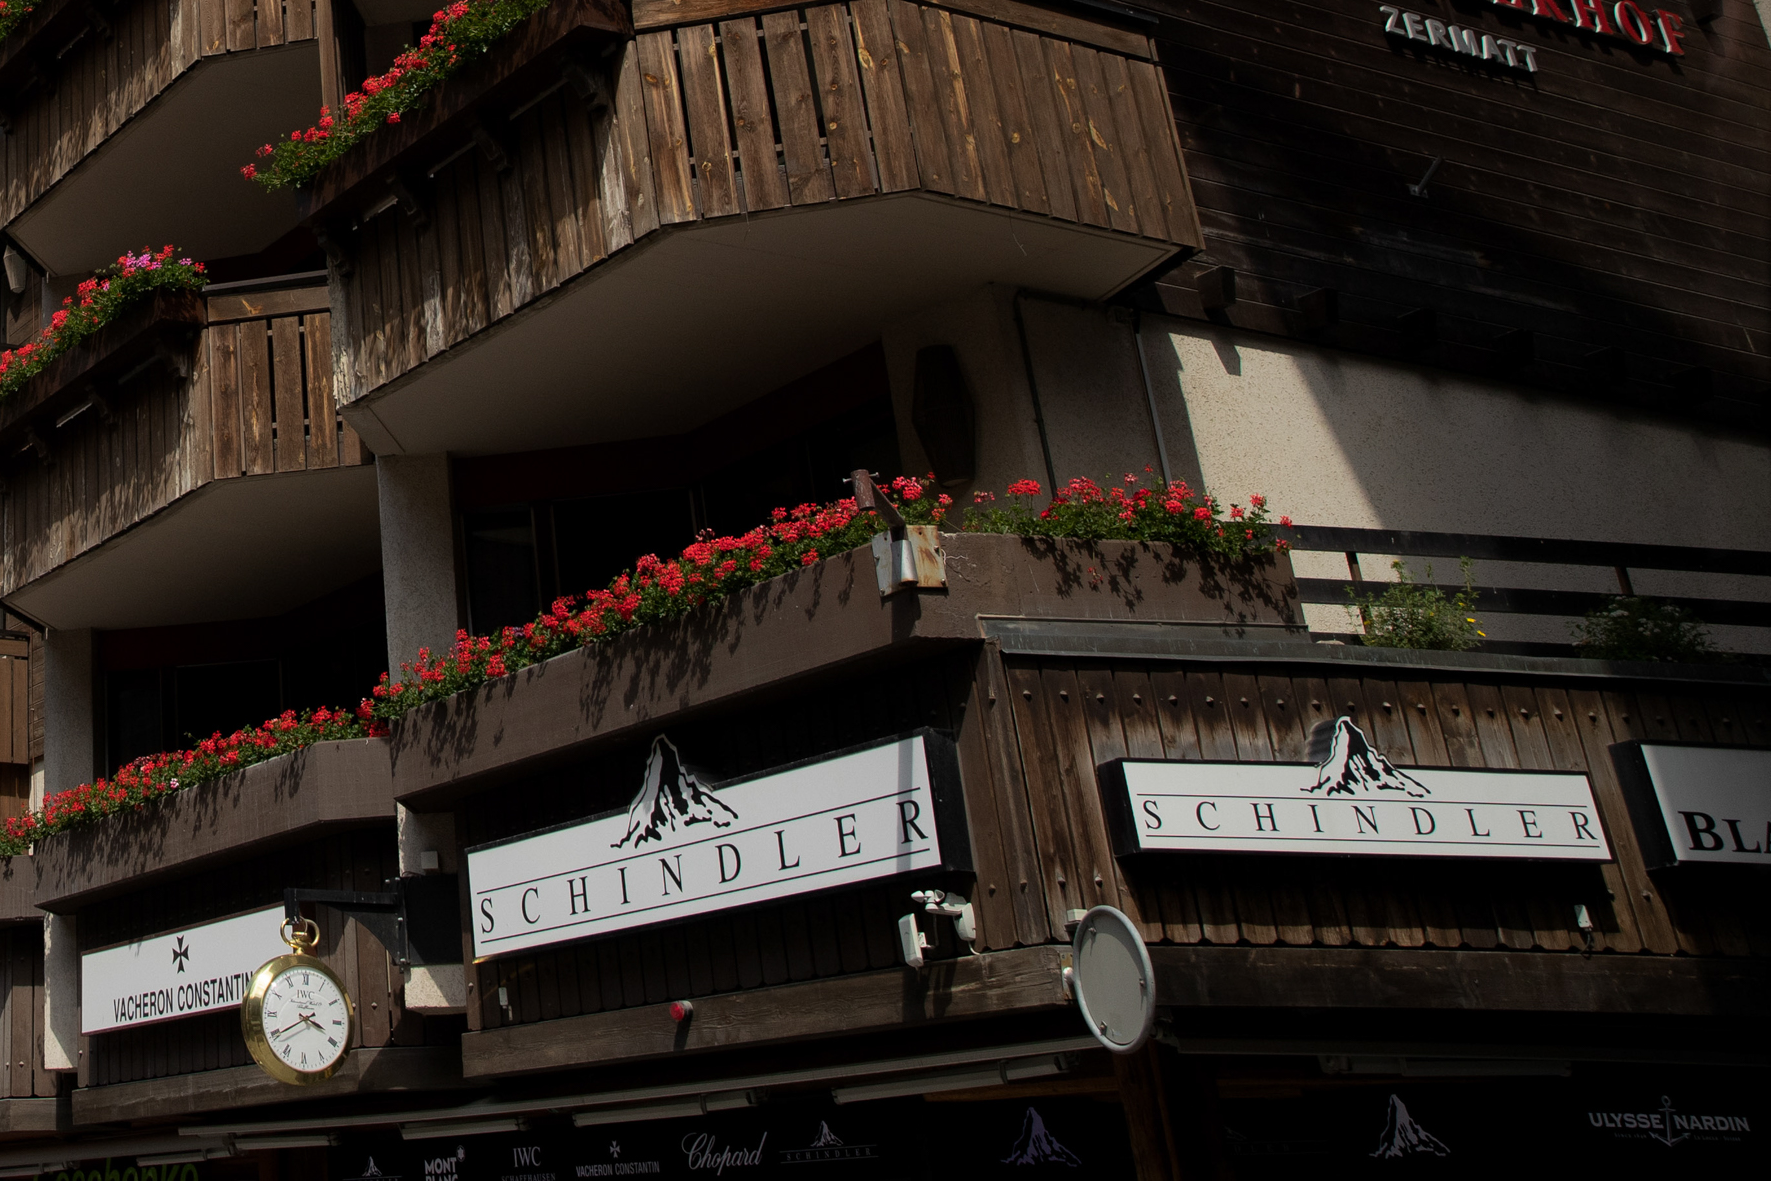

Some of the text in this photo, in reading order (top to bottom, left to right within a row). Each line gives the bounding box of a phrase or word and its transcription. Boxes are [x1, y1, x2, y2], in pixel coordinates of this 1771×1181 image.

[1379, 4, 1539, 73] ZERMATT
[1144, 800, 1599, 841] SCHINDLER
[1678, 811, 1771, 853] BL
[481, 799, 929, 934] SCHINDLER
[114, 971, 253, 1022] VACHERON CONSTANTIN
[297, 989, 315, 1000] IWC
[1587, 1112, 1752, 1132] ULYSSE NARDIN
[513, 1146, 542, 1168] IWC
[681, 1121, 768, 1176] Chopard
[786, 1147, 873, 1161] SCHINDLER
[425, 1157, 457, 1174] MONT
[575, 1161, 660, 1178] VACHERON CONSTANTIN
